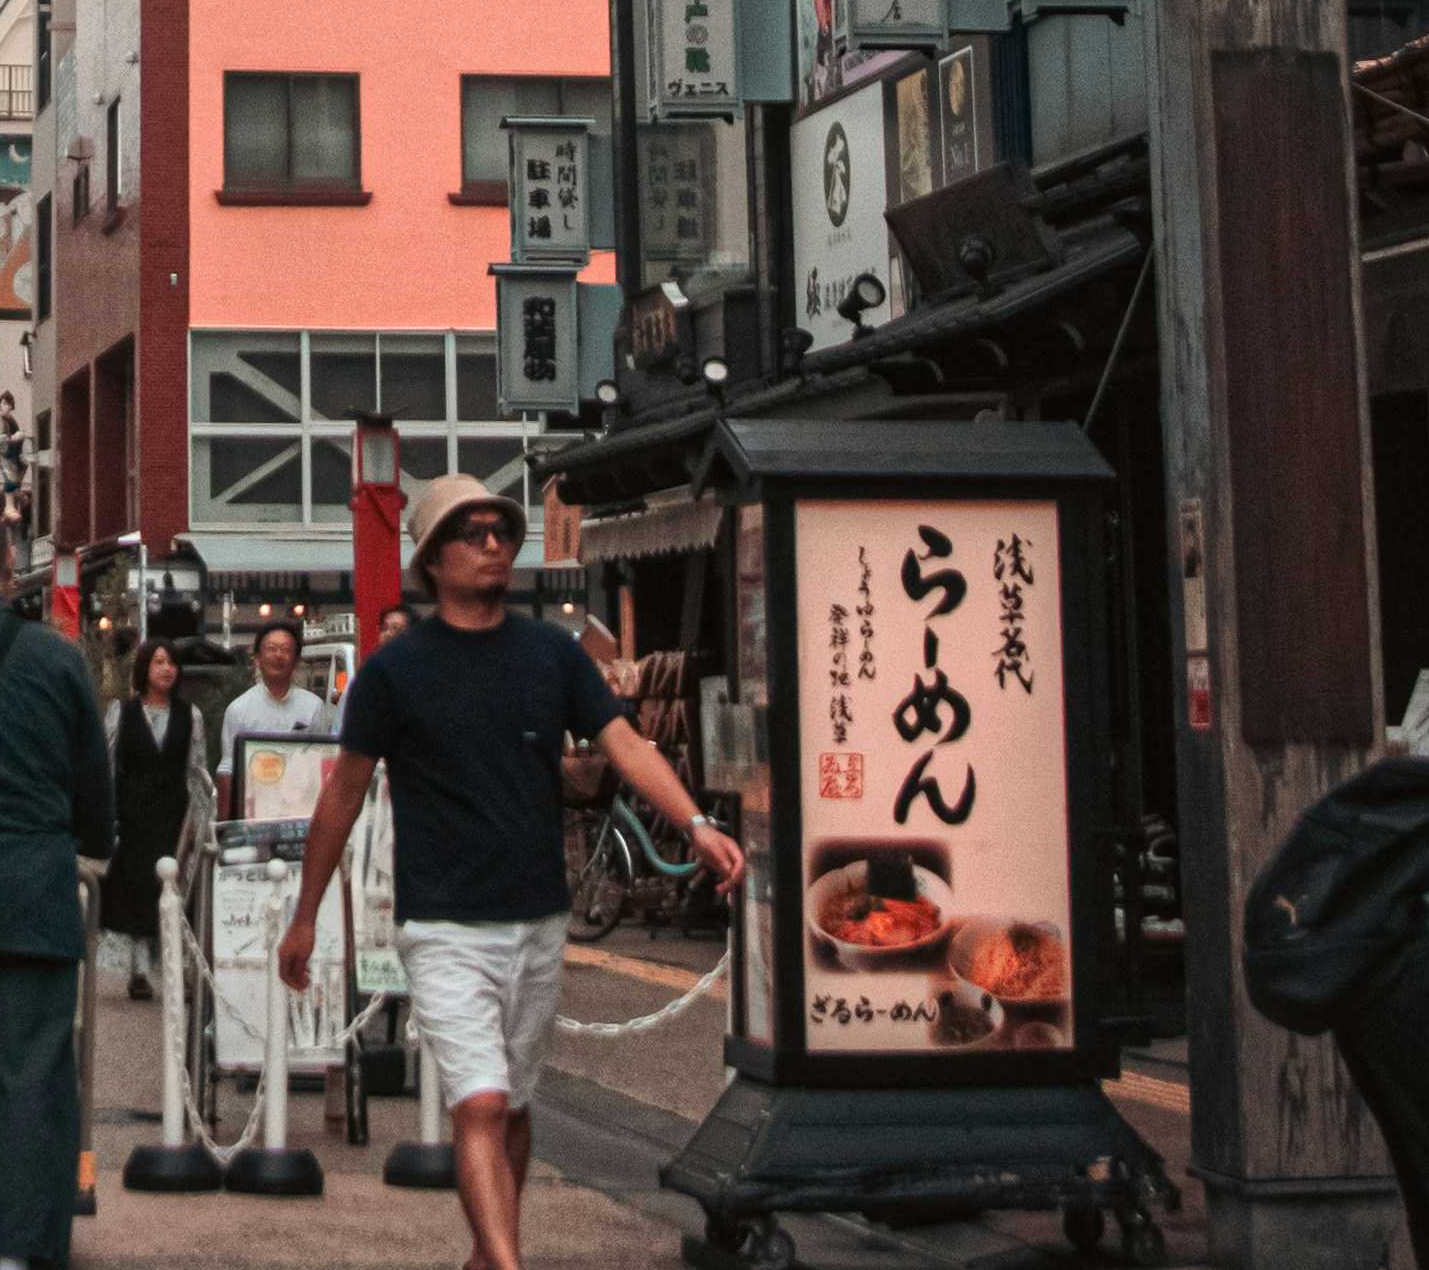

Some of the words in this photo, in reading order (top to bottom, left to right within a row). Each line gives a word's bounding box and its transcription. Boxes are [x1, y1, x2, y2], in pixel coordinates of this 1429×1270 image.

[668, 77, 730, 97] ヴェニス
[526, 158, 552, 240] 駐車場
[555, 139, 579, 231] 時間貸し
[992, 532, 1035, 695] 浅草名代
[892, 524, 977, 825] らーめん
[810, 993, 938, 1025] ざるらーめん
